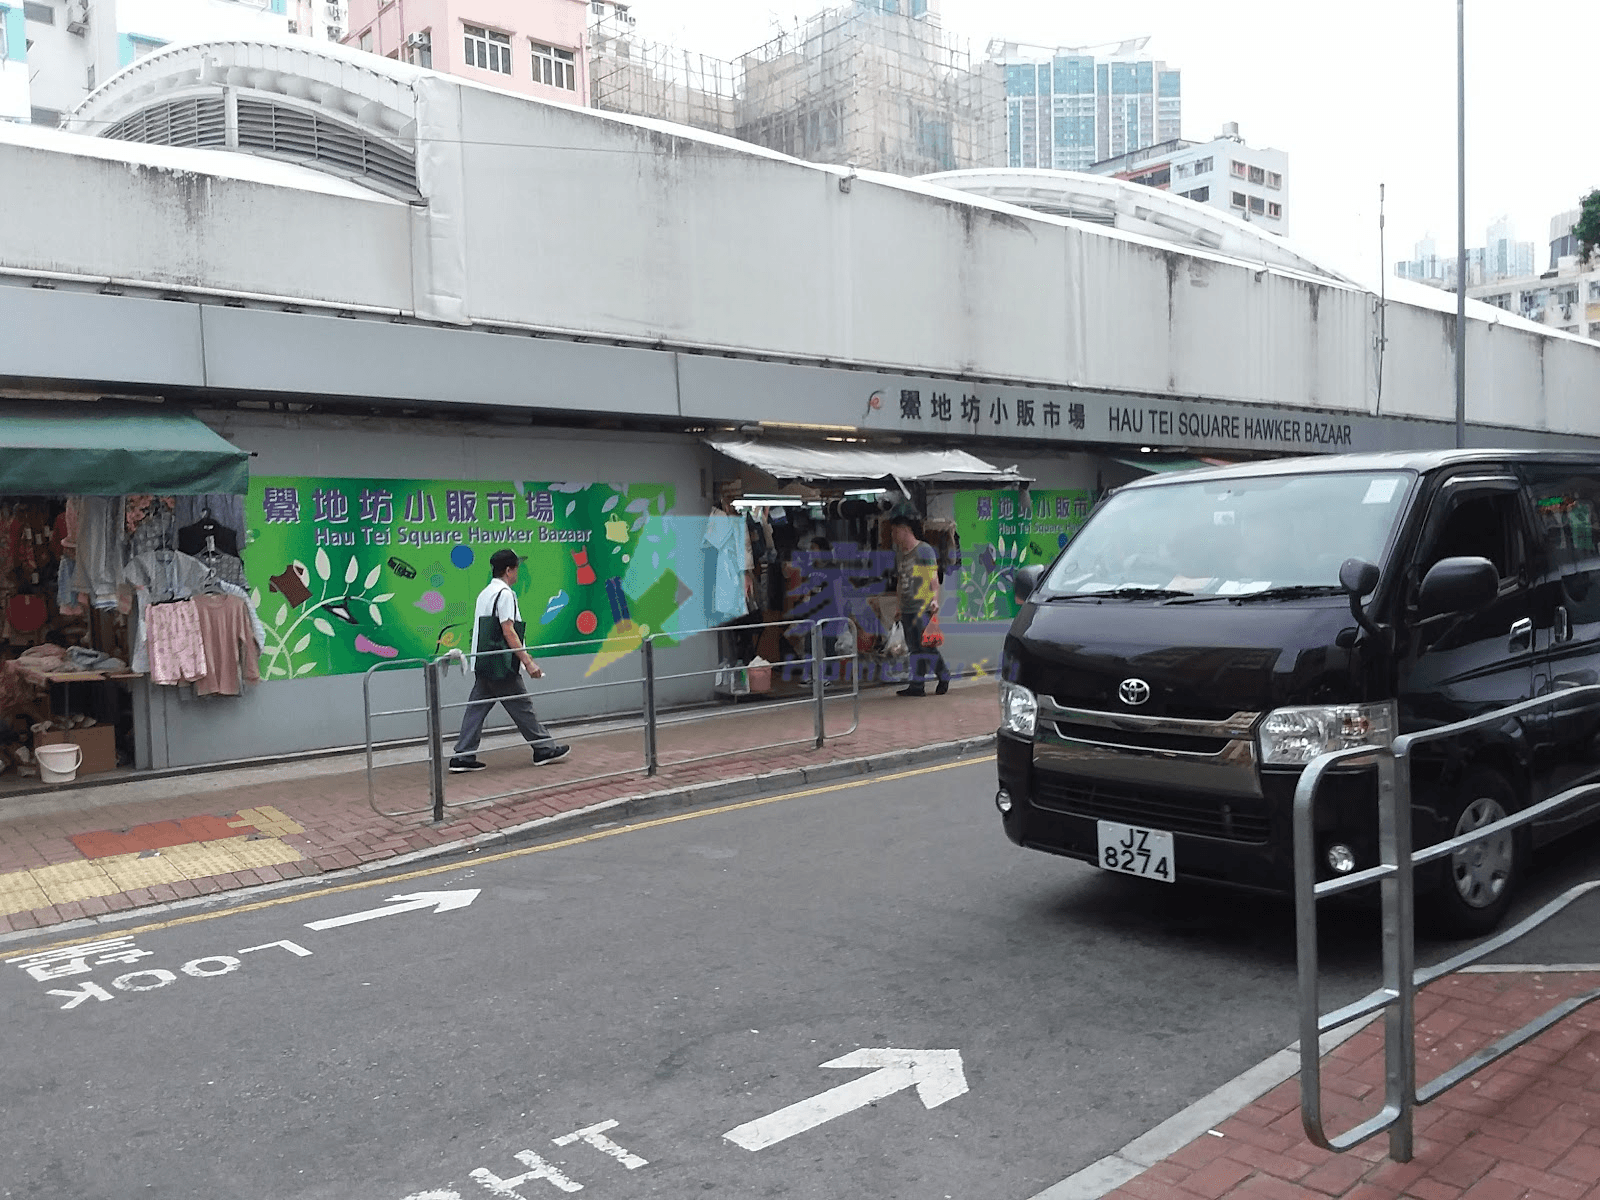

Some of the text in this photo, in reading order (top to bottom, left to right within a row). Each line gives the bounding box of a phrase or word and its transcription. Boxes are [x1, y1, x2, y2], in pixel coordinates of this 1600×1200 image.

[1108, 406, 1352, 446] HAU TEI SQUARE HAWKER BAZAAR
[314, 525, 593, 549] Hau Tei Square Hawker Bazaar
[1120, 828, 1151, 853] JZ
[1104, 846, 1169, 879] 8274
[45, 938, 314, 1010] LOOK
